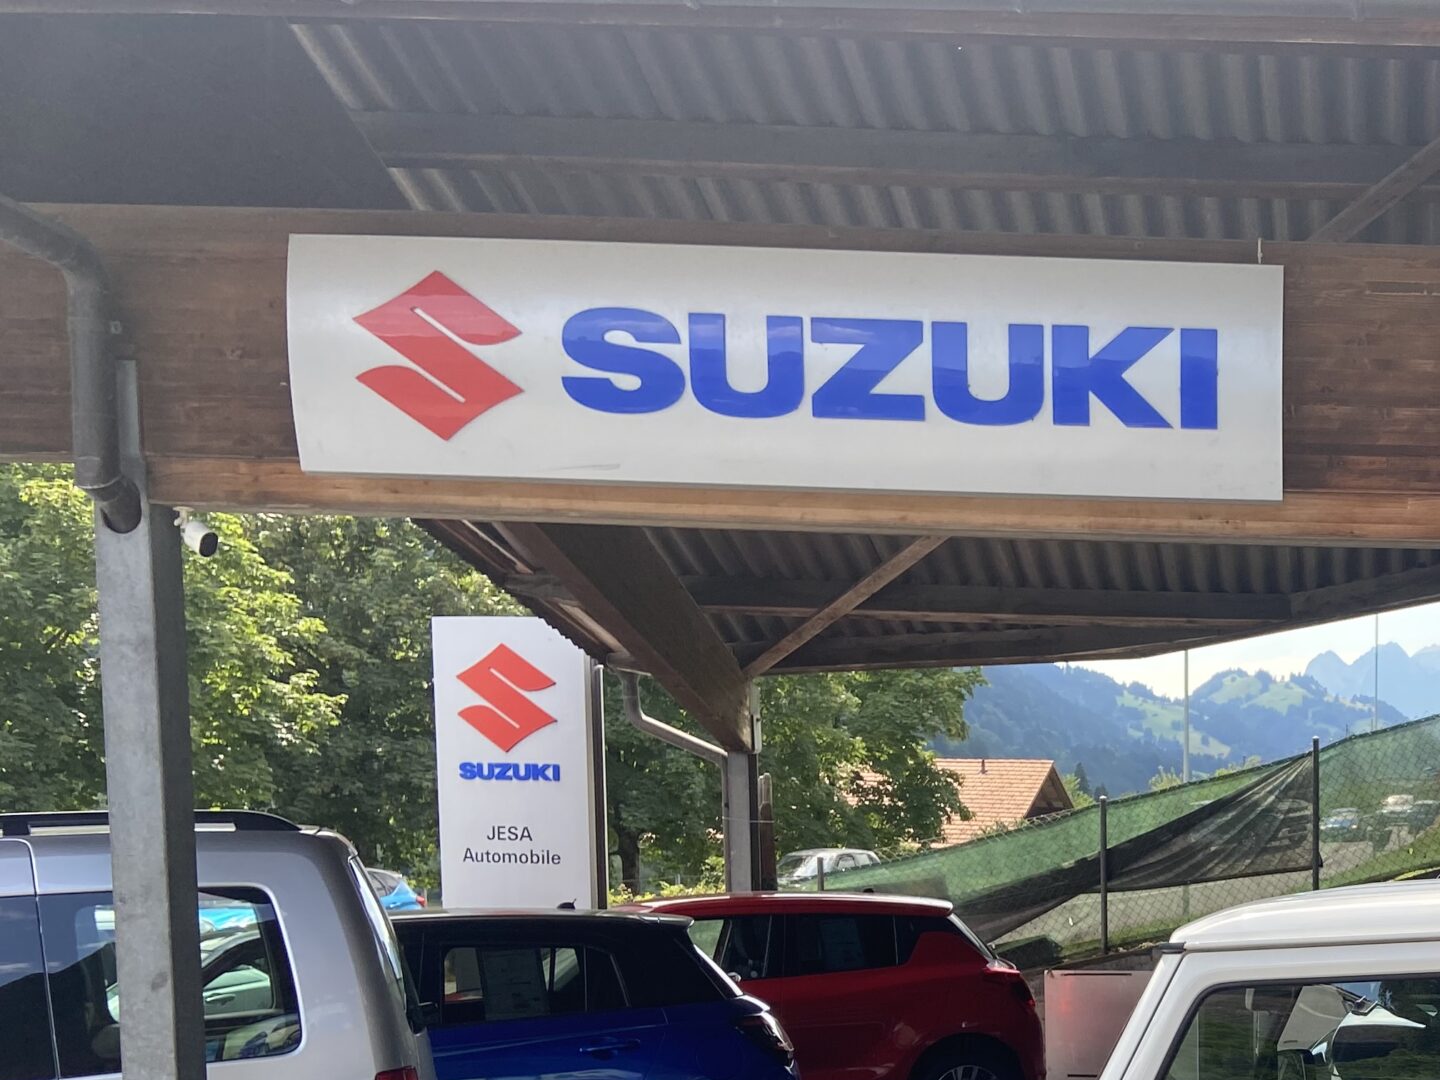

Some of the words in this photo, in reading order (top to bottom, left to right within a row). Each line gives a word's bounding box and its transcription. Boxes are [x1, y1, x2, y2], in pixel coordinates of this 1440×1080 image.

[561, 306, 1218, 430] SUZUKI
[459, 762, 561, 782] SUZUKI
[486, 826, 533, 842] JESA
[463, 848, 561, 865] Automobile
